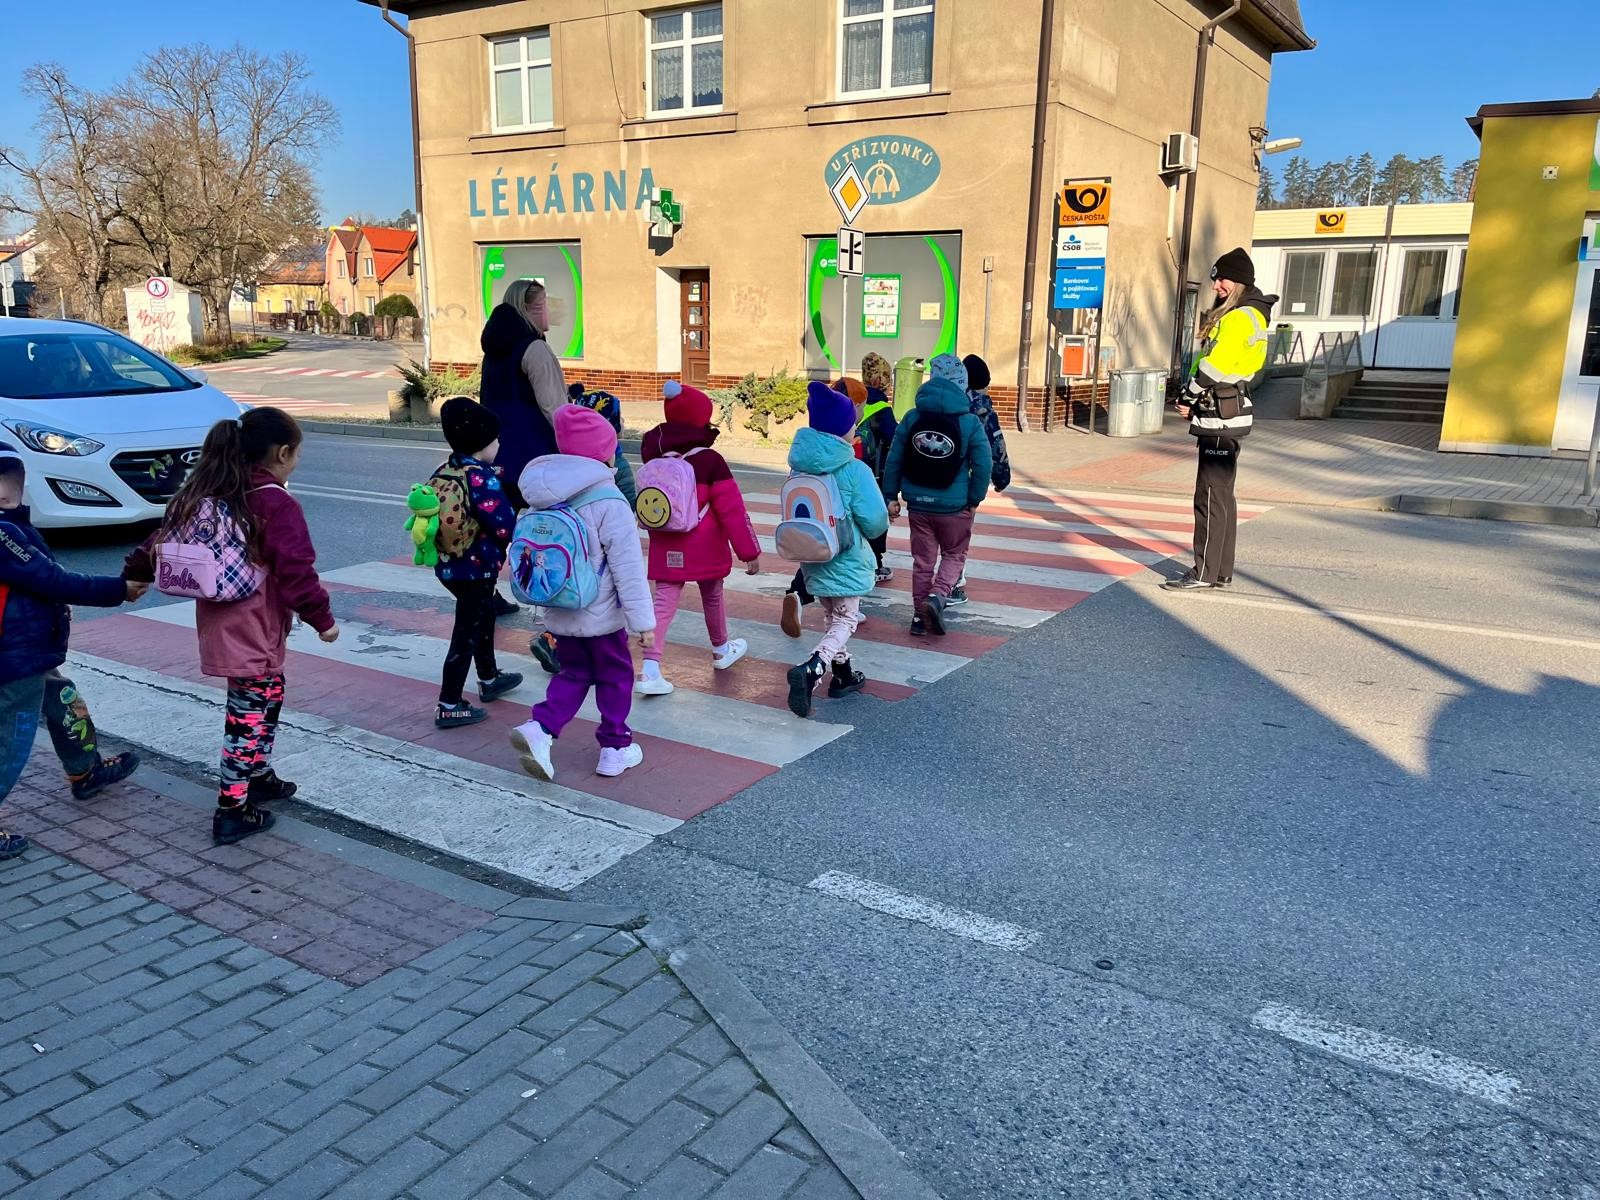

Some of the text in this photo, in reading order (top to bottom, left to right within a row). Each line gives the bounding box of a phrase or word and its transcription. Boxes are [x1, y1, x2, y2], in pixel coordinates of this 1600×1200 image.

[468, 162, 656, 218] LÉKÁRNA
[1204, 448, 1229, 456] POLICIE
[159, 562, 200, 590] Barbie
